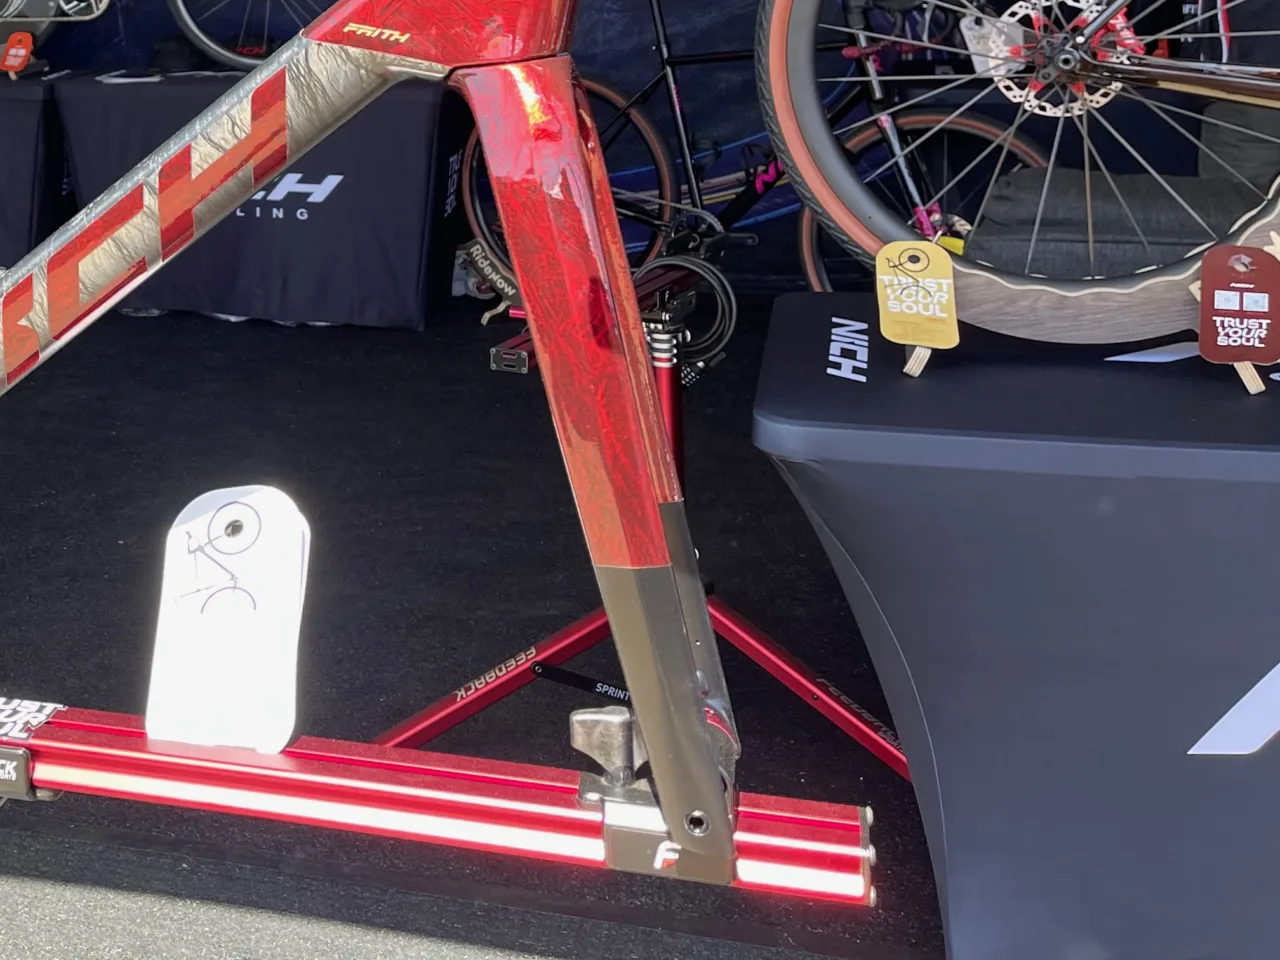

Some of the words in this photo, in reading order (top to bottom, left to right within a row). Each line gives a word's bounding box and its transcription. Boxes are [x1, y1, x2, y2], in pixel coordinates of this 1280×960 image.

[236, 207, 308, 220] LING
[879, 275, 952, 293] TRUST
[886, 288, 949, 304] YOUR
[887, 301, 948, 317] SOUL
[1212, 316, 1271, 329] TRUST
[1218, 326, 1268, 339] YOUR
[826, 316, 869, 382] NICH
[1216, 336, 1265, 347] SOUL
[454, 646, 537, 702] FEEDBACK
[595, 682, 630, 701] SPRINT
